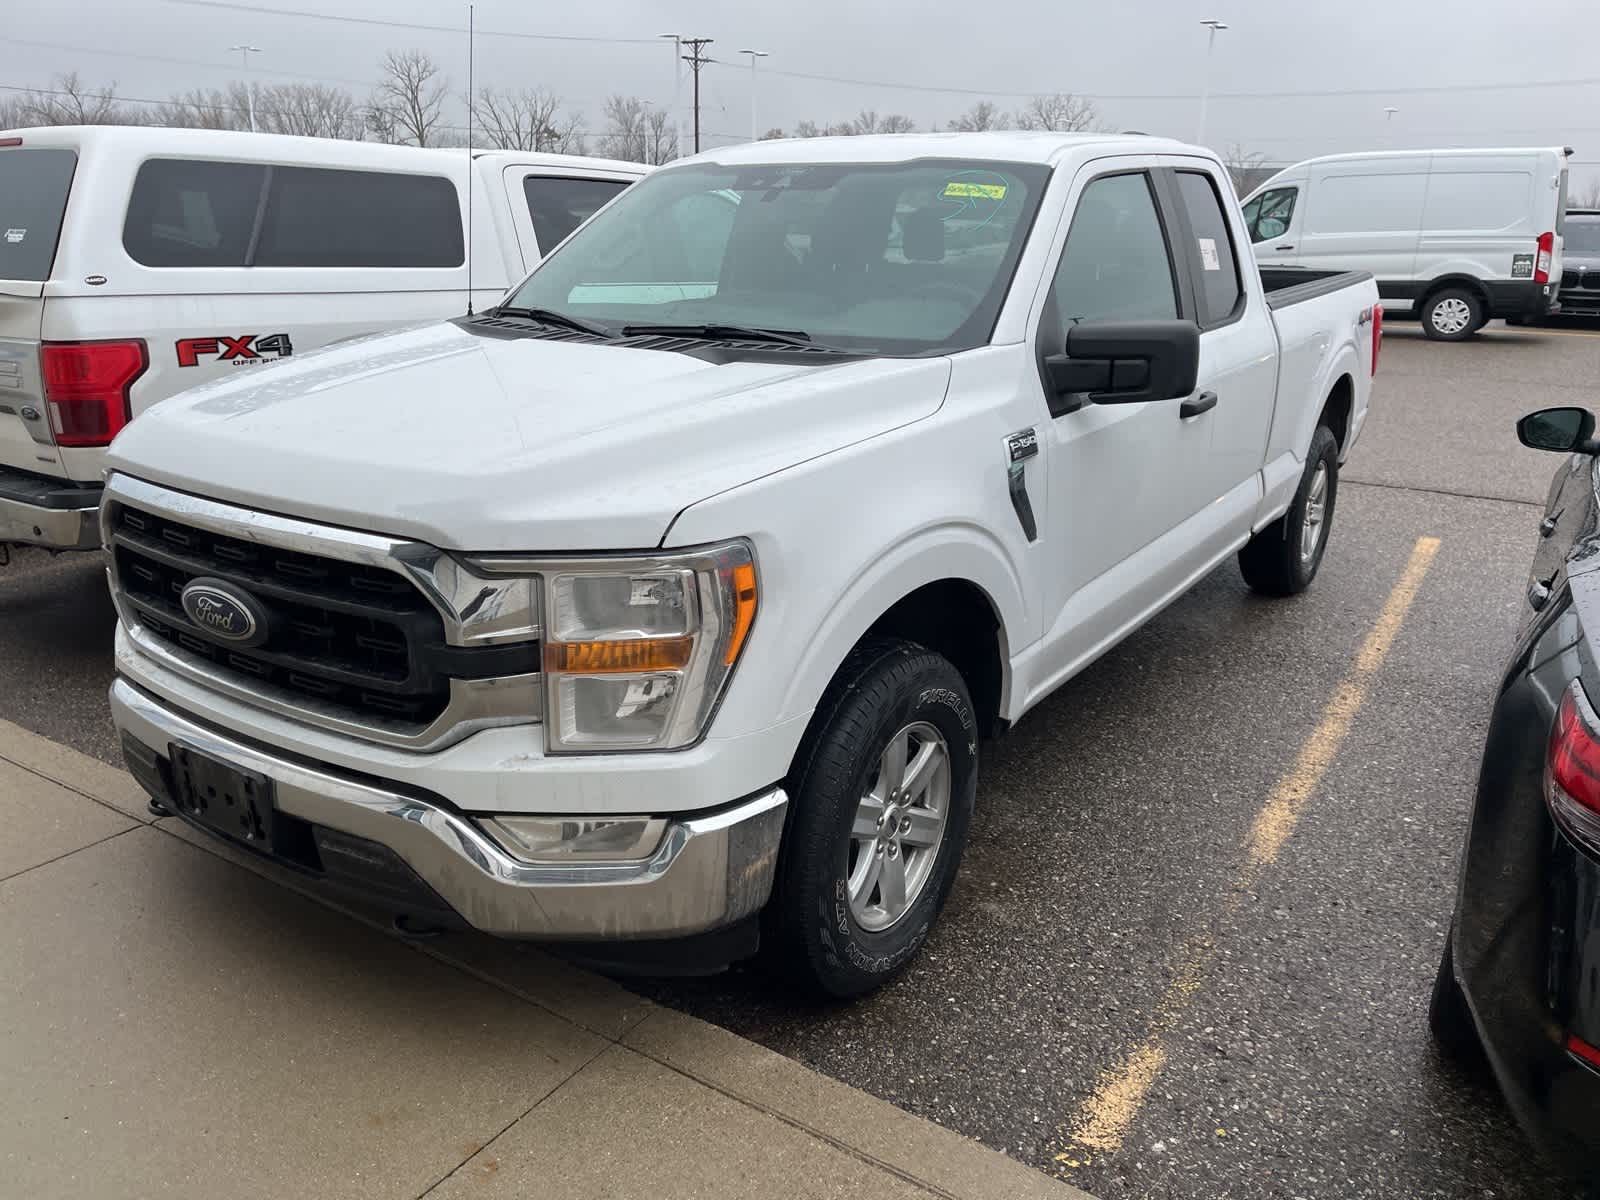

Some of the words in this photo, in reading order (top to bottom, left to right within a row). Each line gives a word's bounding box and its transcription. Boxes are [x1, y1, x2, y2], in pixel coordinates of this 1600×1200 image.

[175, 334, 293, 367] FX4
[196, 596, 233, 630] Ford
[917, 688, 972, 730] PIRELLI
